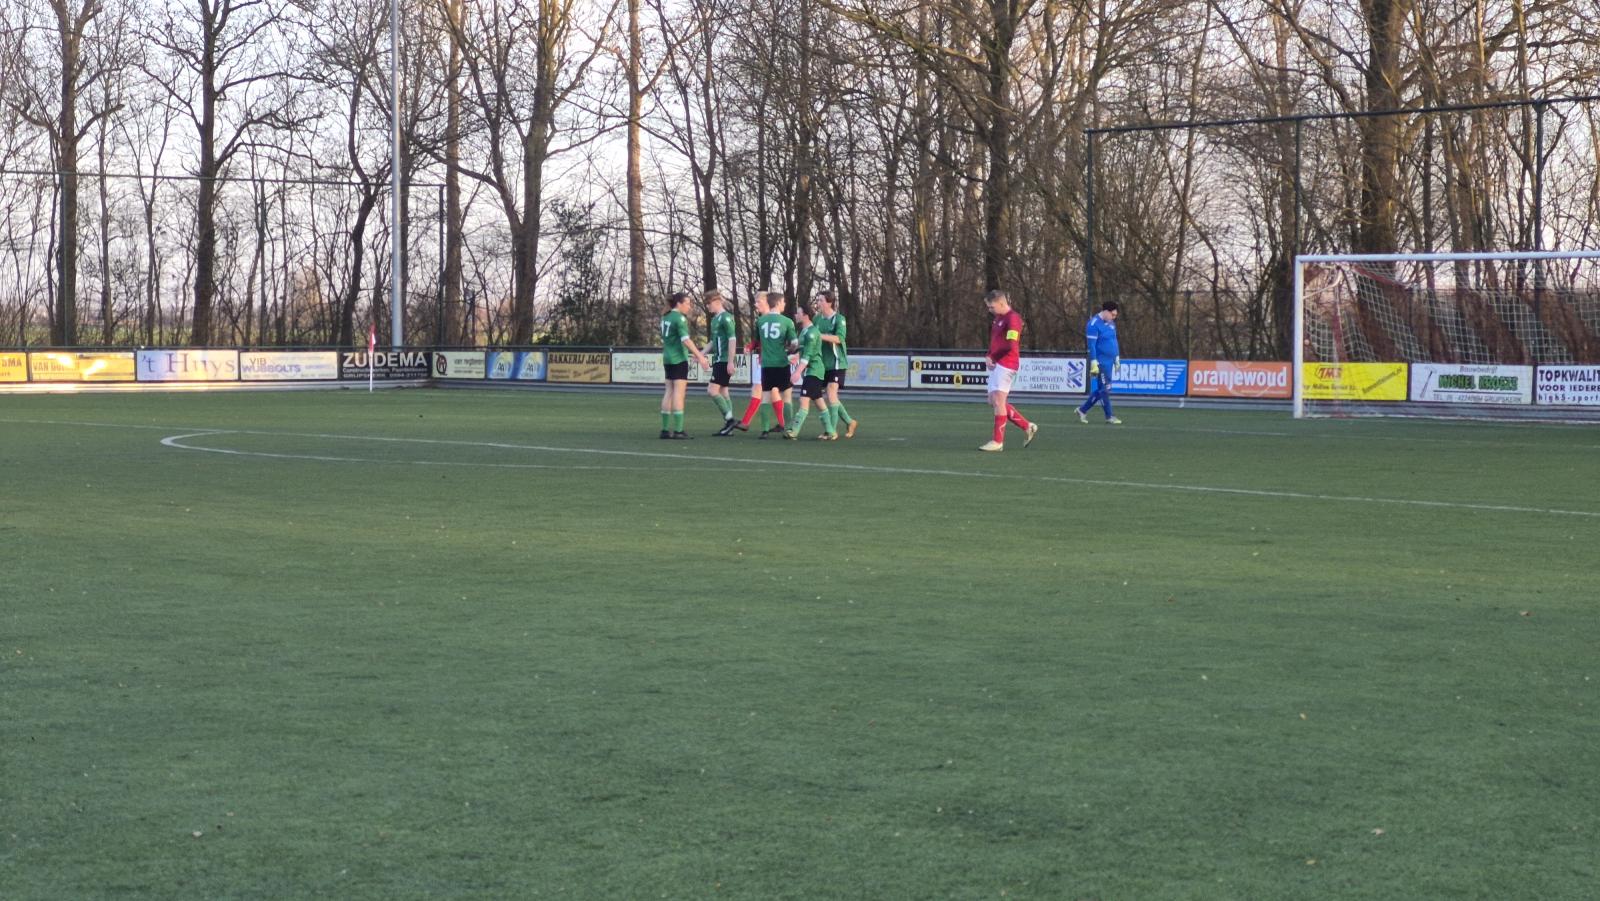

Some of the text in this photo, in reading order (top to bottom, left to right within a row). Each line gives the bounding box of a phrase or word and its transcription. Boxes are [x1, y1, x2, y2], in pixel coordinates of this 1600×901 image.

[761, 321, 780, 339] 15
[1193, 366, 1287, 390] oranjewoud
[1538, 384, 1566, 392] VOOR
